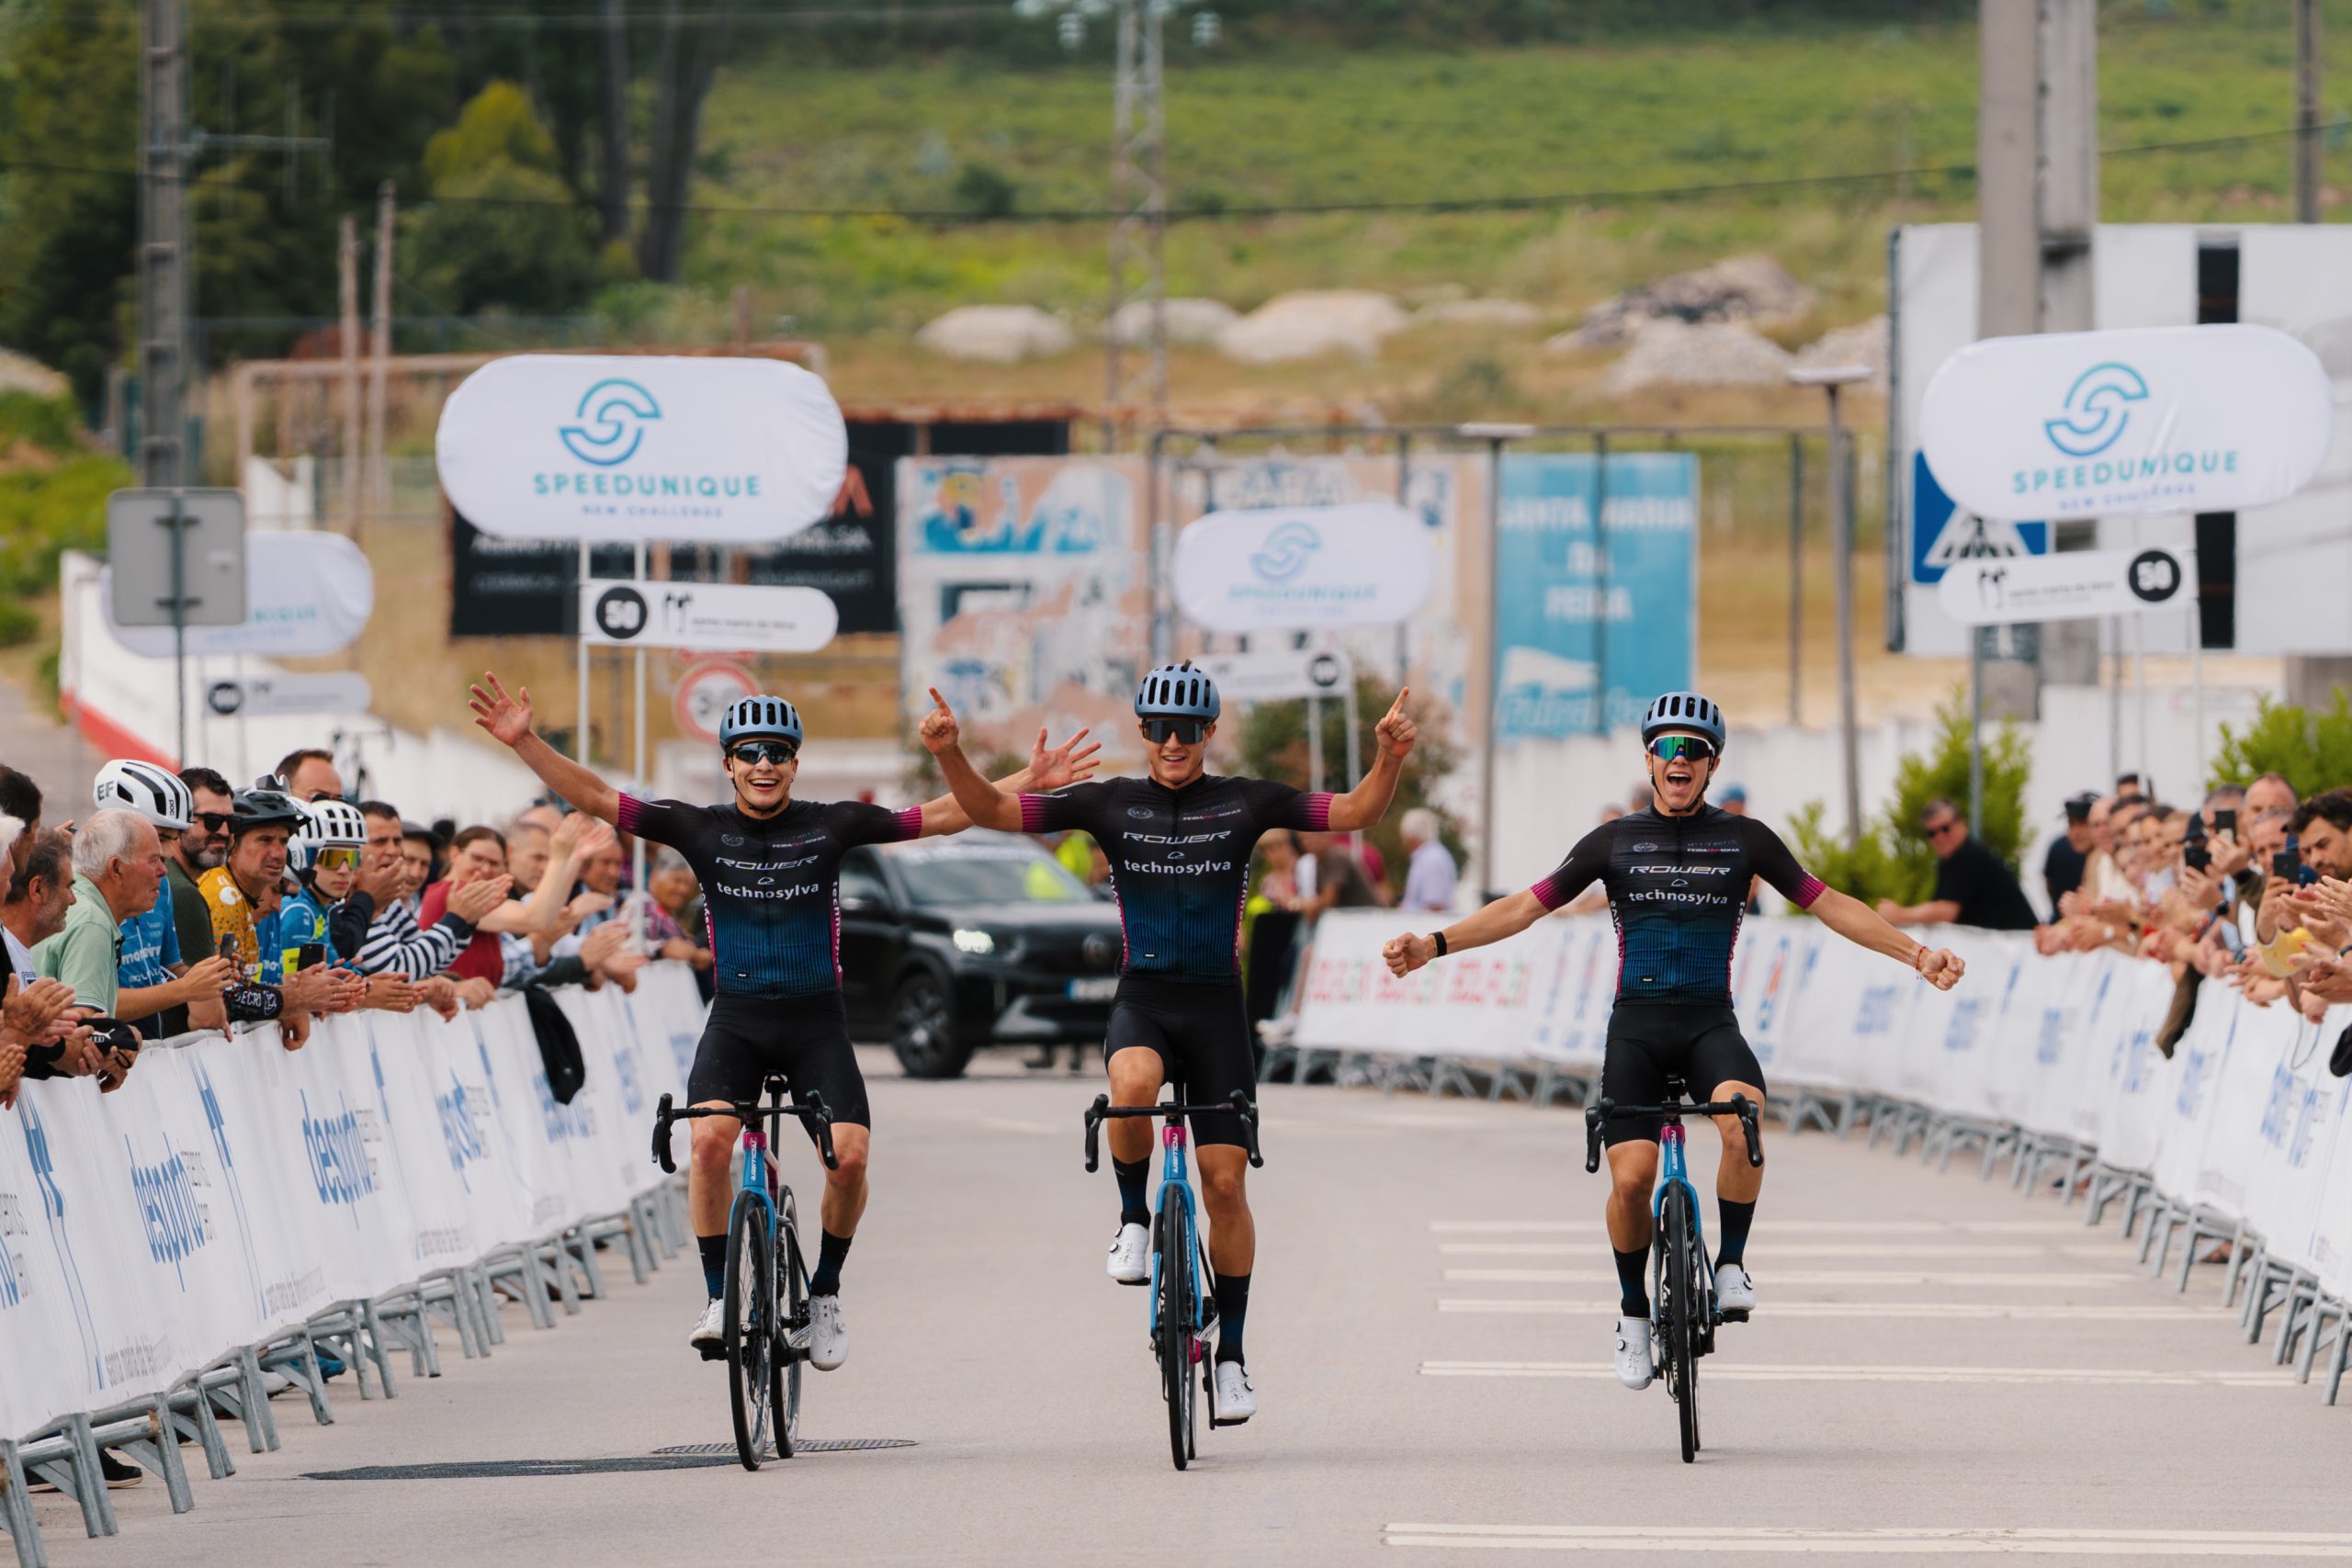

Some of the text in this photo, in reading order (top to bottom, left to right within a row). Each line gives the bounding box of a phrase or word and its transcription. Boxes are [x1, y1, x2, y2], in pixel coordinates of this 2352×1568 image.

[2013, 451, 2237, 493] SPEEDUNIQUE
[534, 473, 761, 497] SPEEDUNIQUE
[581, 504, 618, 515] NEW
[97, 780, 114, 802] EF
[1123, 830, 1232, 844] ROWER
[716, 854, 820, 870] ROWER
[1124, 859, 1232, 875] technosylva
[1629, 865, 1731, 875] ROWER
[717, 882, 820, 900] technosylva
[1628, 888, 1728, 905] technosylva
[125, 1132, 206, 1293] desporto
